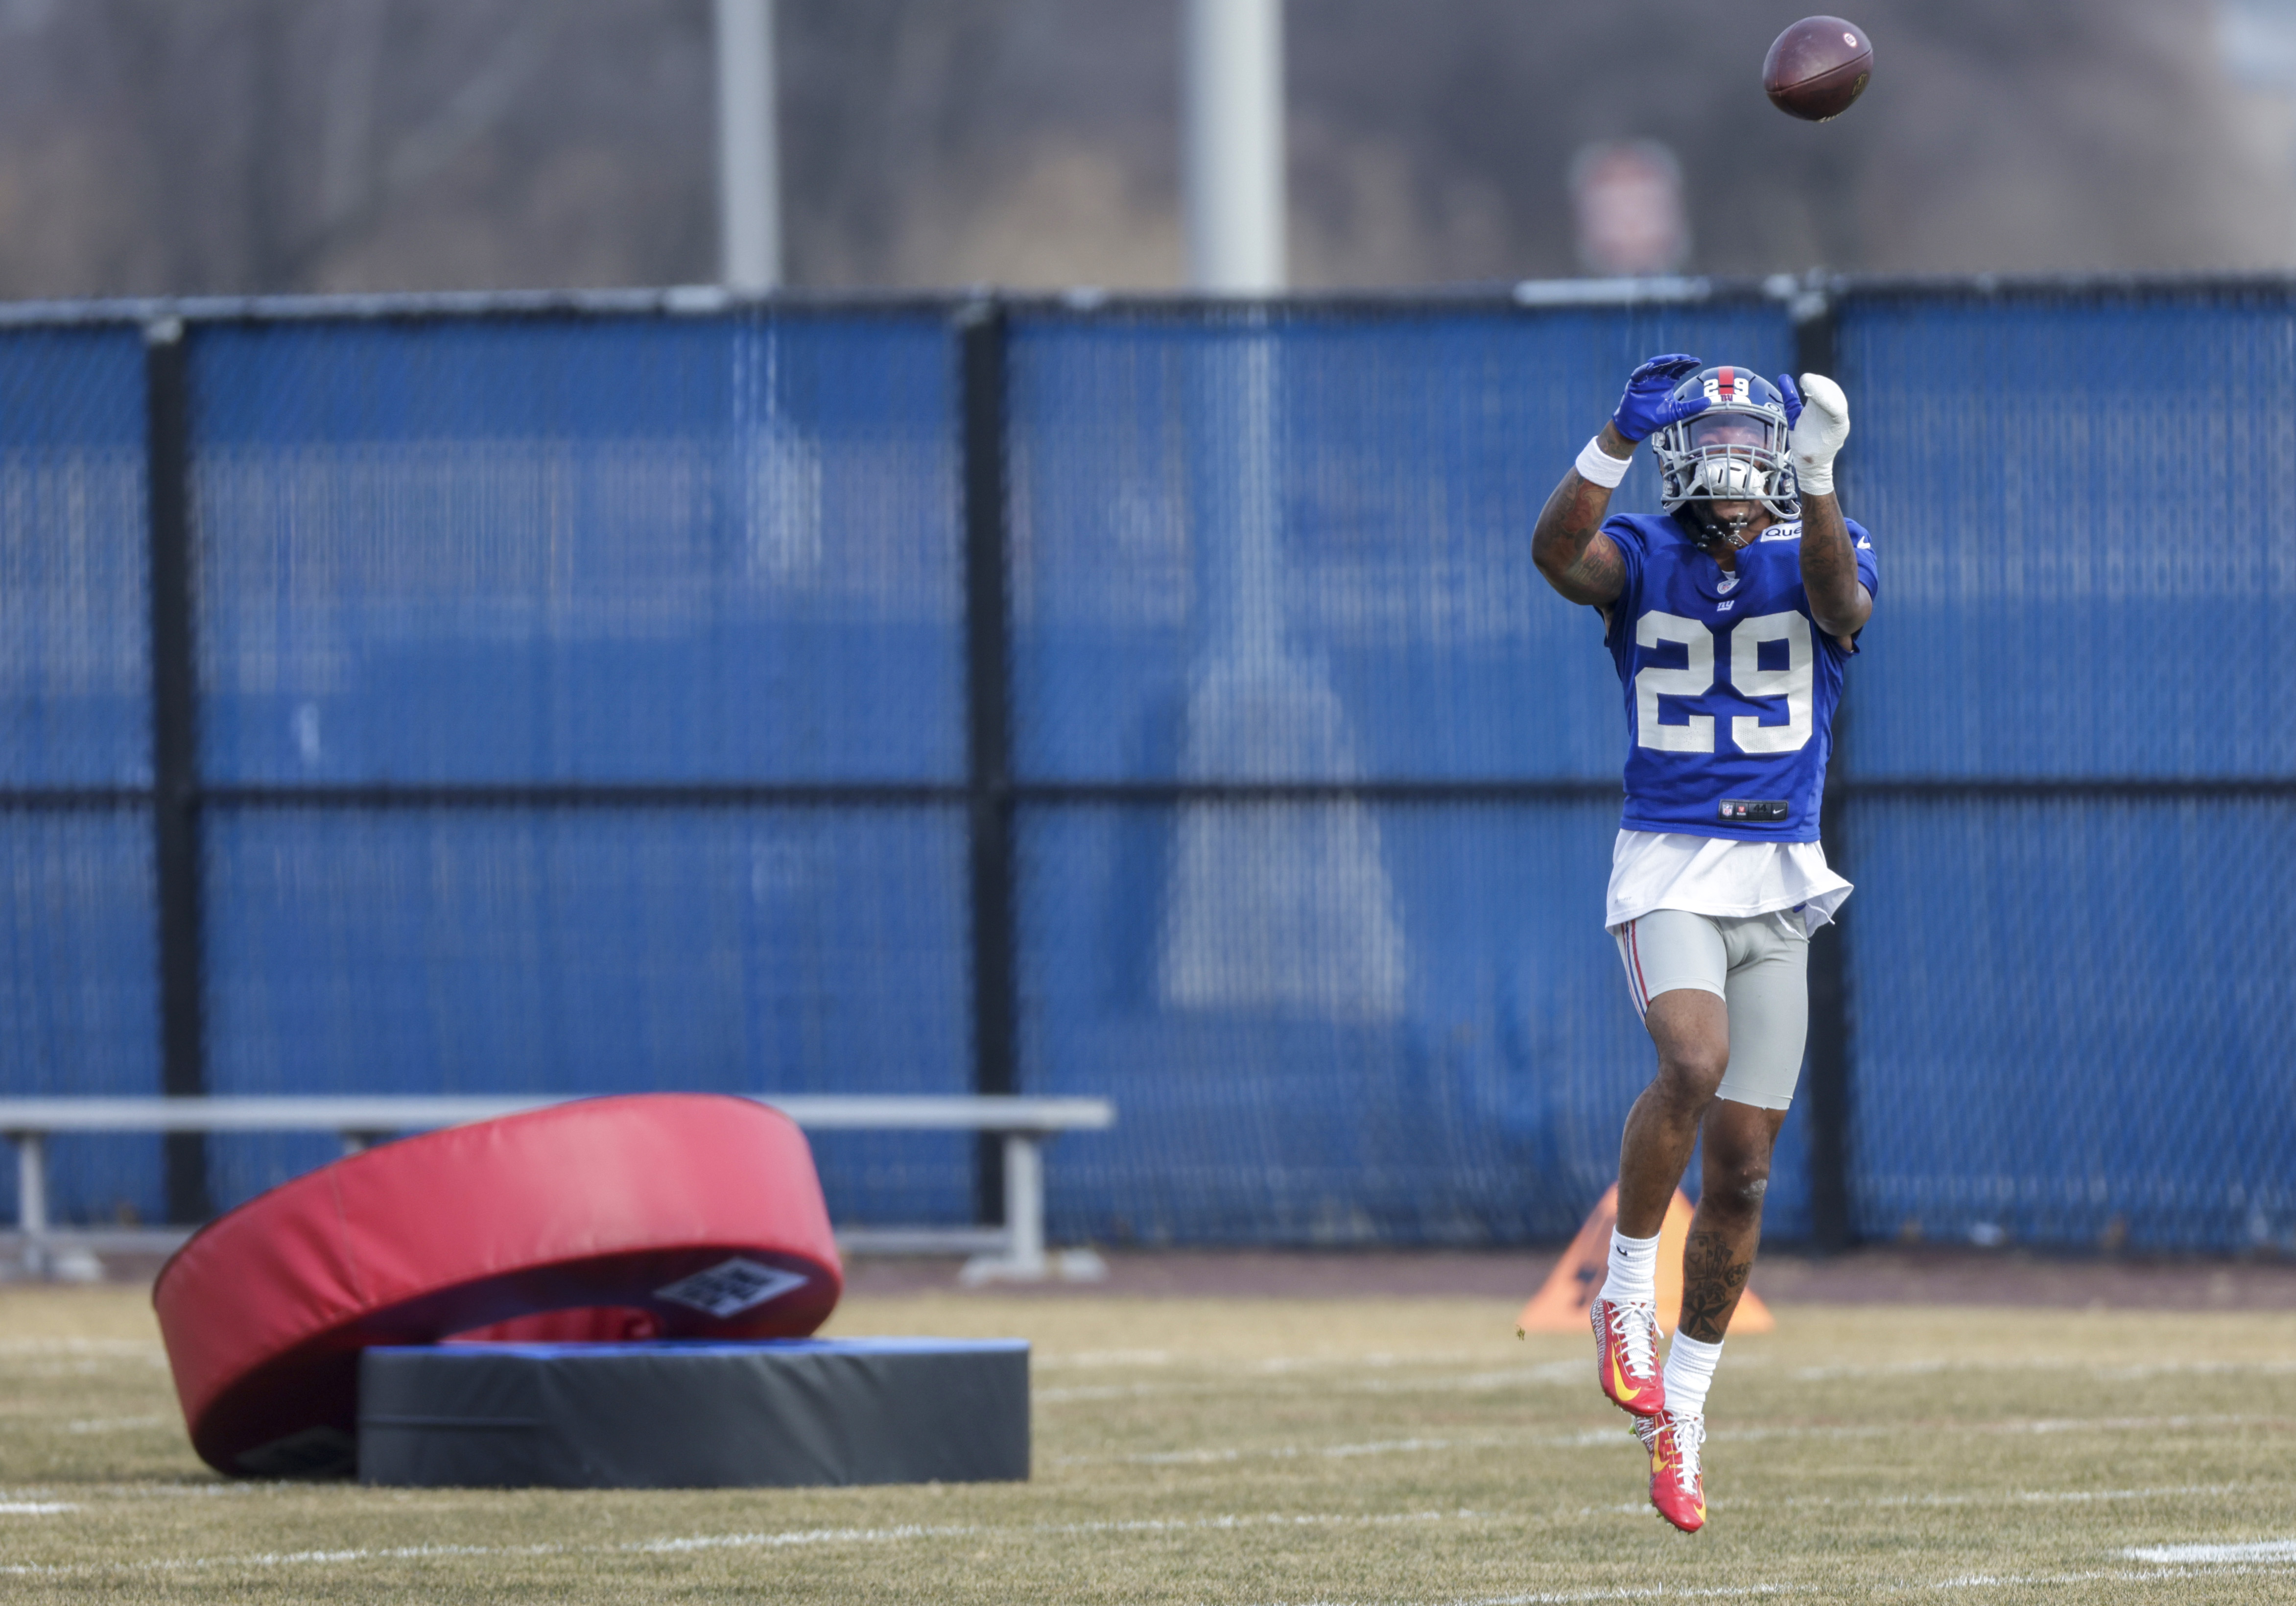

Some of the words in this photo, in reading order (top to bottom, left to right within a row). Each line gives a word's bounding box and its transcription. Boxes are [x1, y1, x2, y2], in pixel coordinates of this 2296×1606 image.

[1704, 378, 1749, 397] 29
[1634, 609, 1813, 754] 29
[1754, 804, 1767, 812] 44
